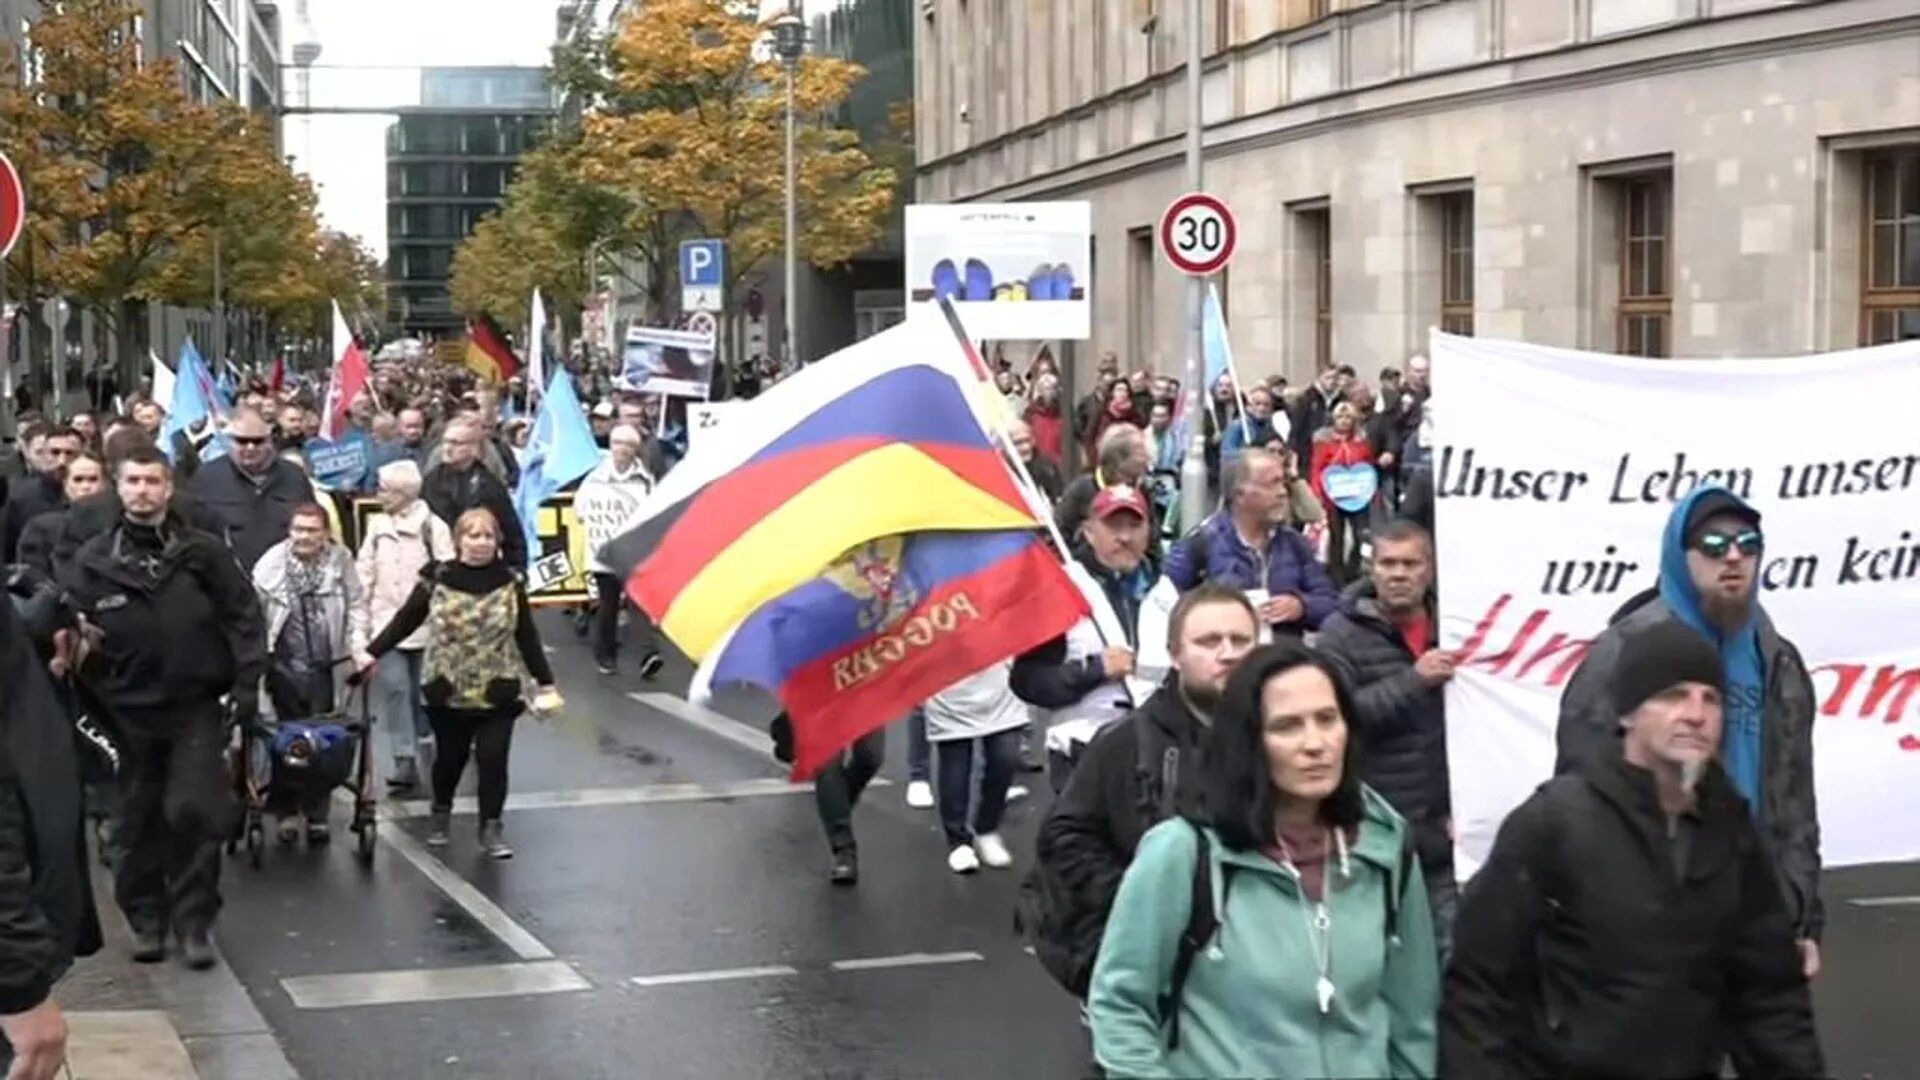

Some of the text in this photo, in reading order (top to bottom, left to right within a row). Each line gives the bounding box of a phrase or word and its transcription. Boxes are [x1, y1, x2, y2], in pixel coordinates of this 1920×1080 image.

[1178, 216, 1221, 251] 30
[689, 247, 711, 281] P
[1437, 445, 1588, 502] Unser
[1541, 545, 1638, 595] wir
